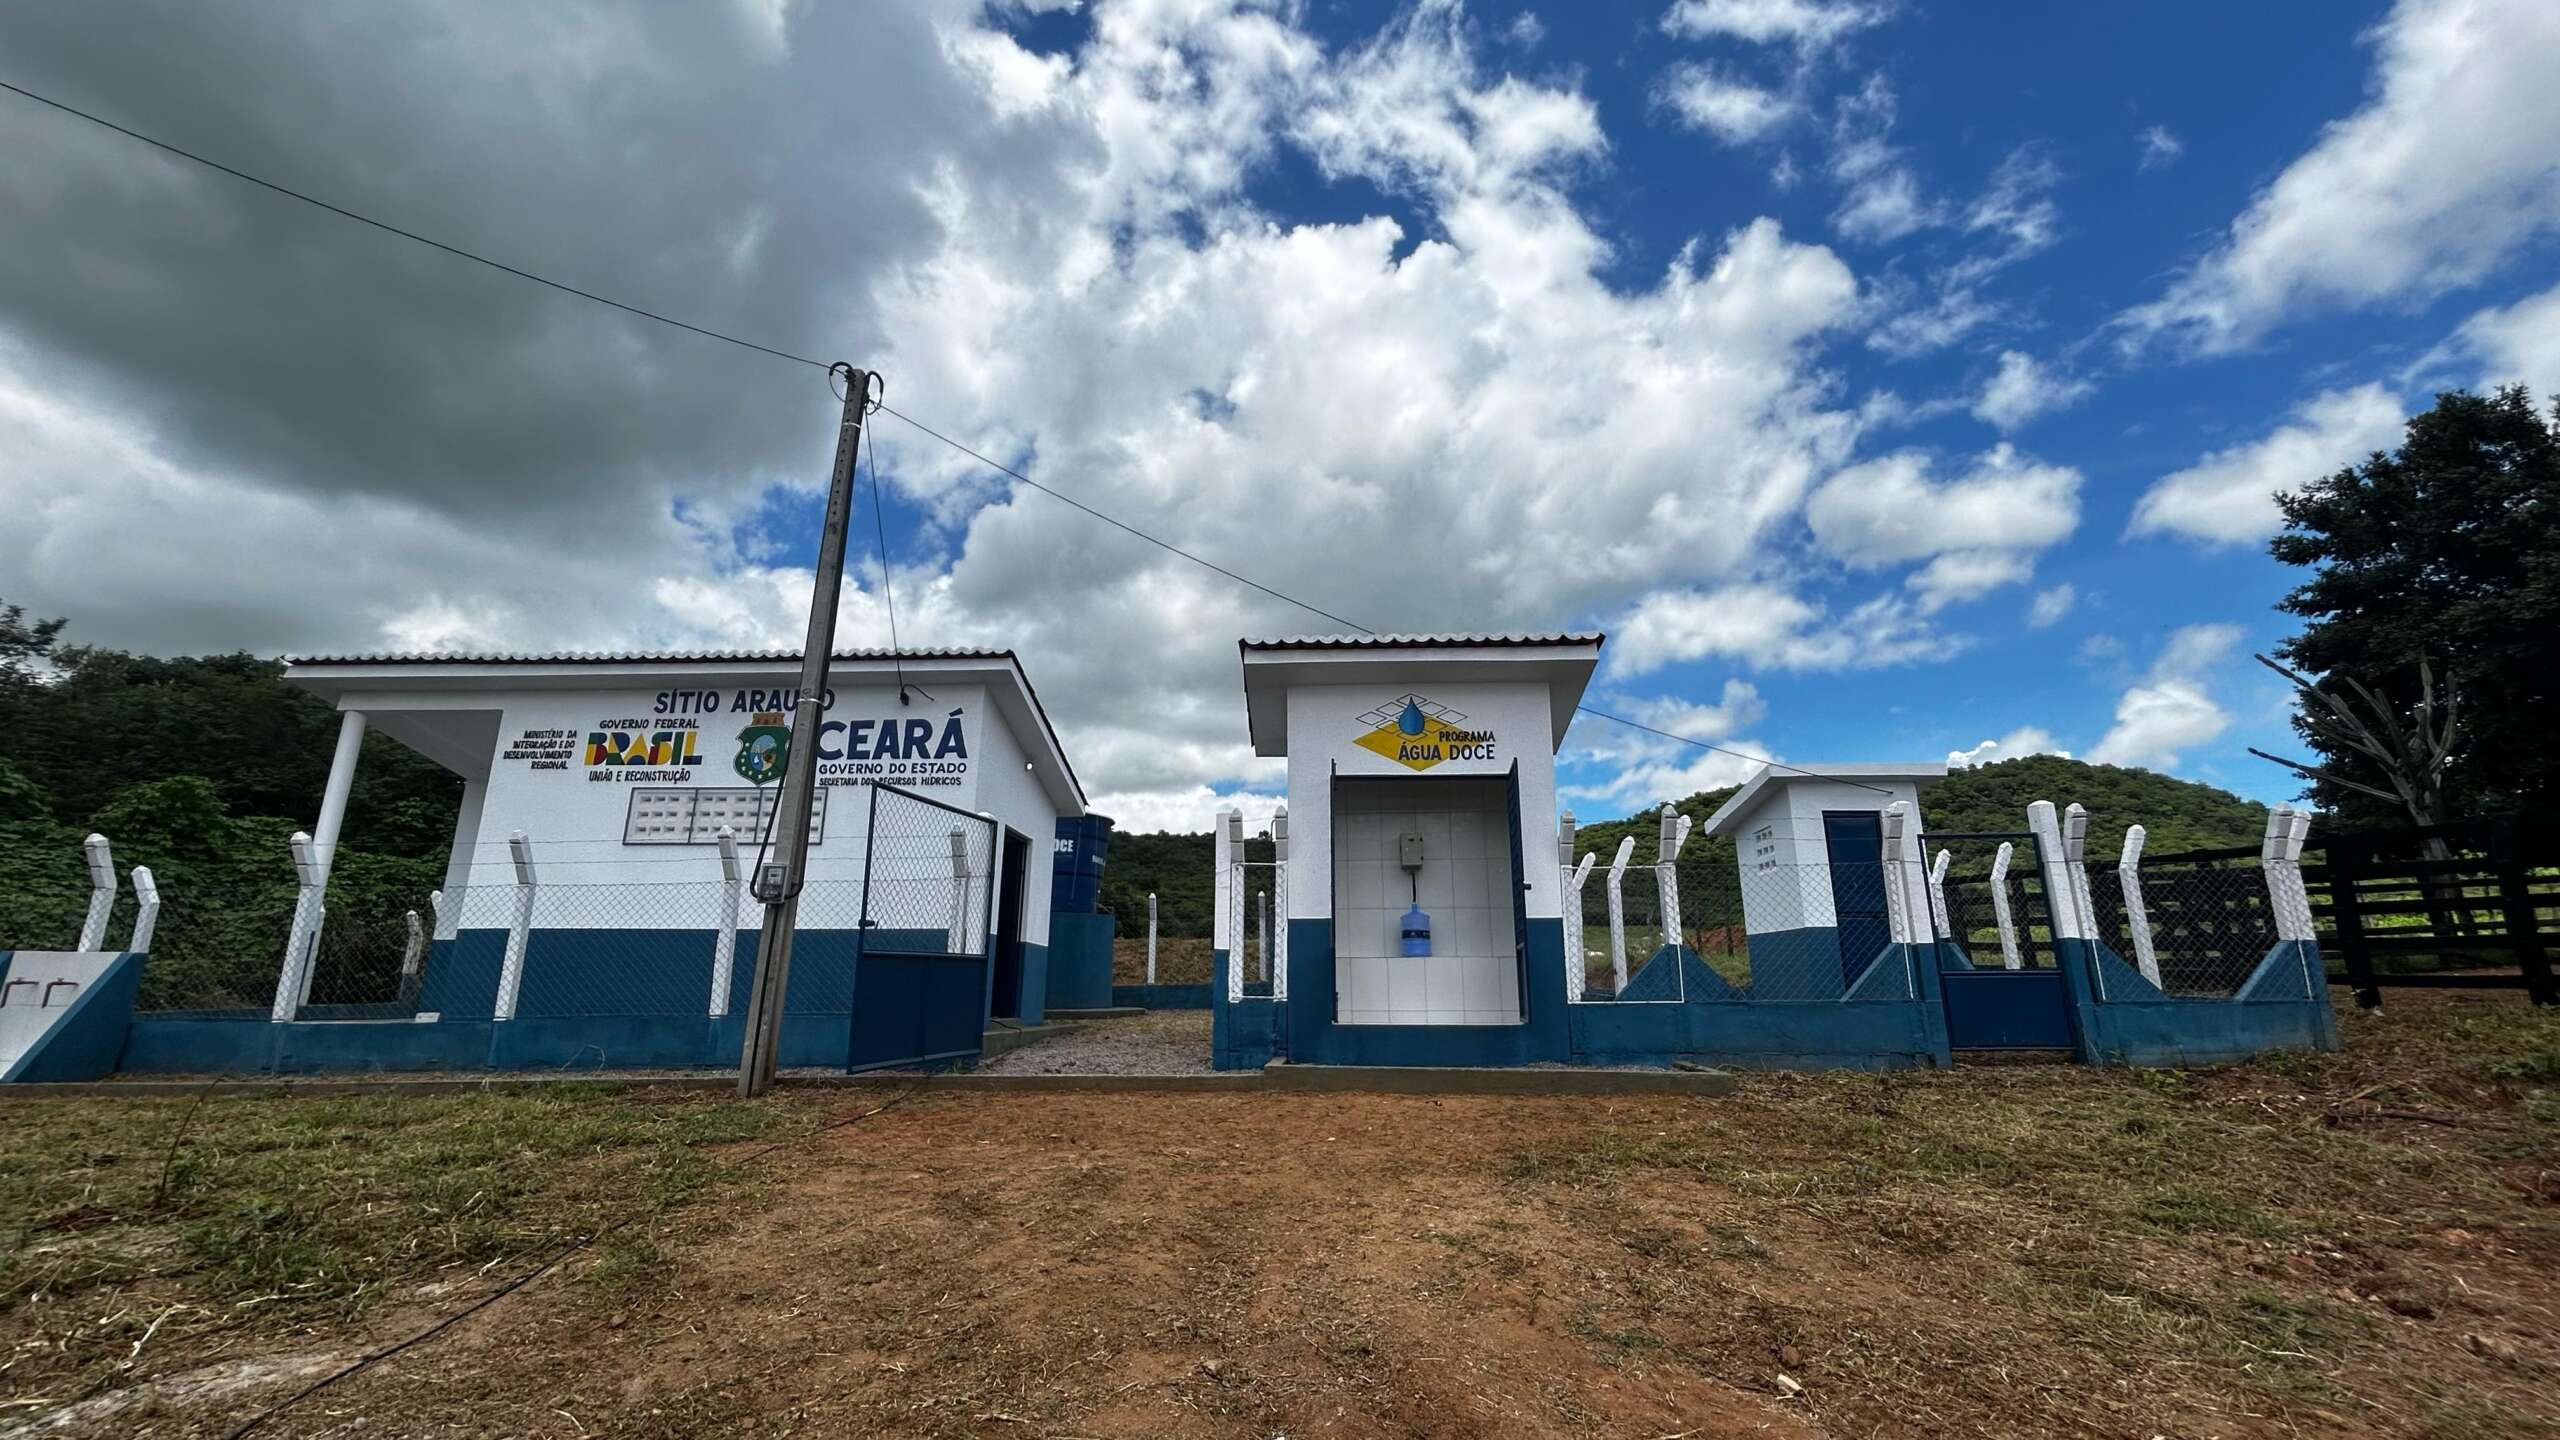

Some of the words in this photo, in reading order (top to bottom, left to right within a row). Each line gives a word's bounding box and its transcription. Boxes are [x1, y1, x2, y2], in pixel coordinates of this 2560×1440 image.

[653, 688, 720, 714] SÍTIO
[730, 688, 836, 713] ARAUO
[599, 719, 649, 729] GOVERNO
[654, 718, 700, 729] FEDERAL
[523, 728, 564, 739] MINISTÉRIO
[566, 729, 577, 739] DA
[816, 707, 969, 760] CEARÁ
[1438, 731, 1496, 743] PROGRAMA
[512, 739, 558, 750] INTEGRAÇÃO
[558, 740, 564, 749] E
[564, 740, 576, 749] DO
[583, 731, 703, 766] BRASIL
[1398, 741, 1442, 760] ÁGUA
[1449, 743, 1495, 760] DOCE
[503, 750, 573, 760] DESENVOLVIMENTO
[530, 760, 568, 770] REGIONAL
[818, 763, 883, 775] GOVERNO
[889, 763, 907, 775] DO
[910, 762, 967, 774] ESTADO
[588, 768, 613, 783] UNIÃO
[616, 770, 623, 782] E
[624, 767, 691, 784] RECONSTRUÇÃO
[819, 777, 859, 787] SECRETARIA
[921, 773, 962, 786] HÍDRICOS
